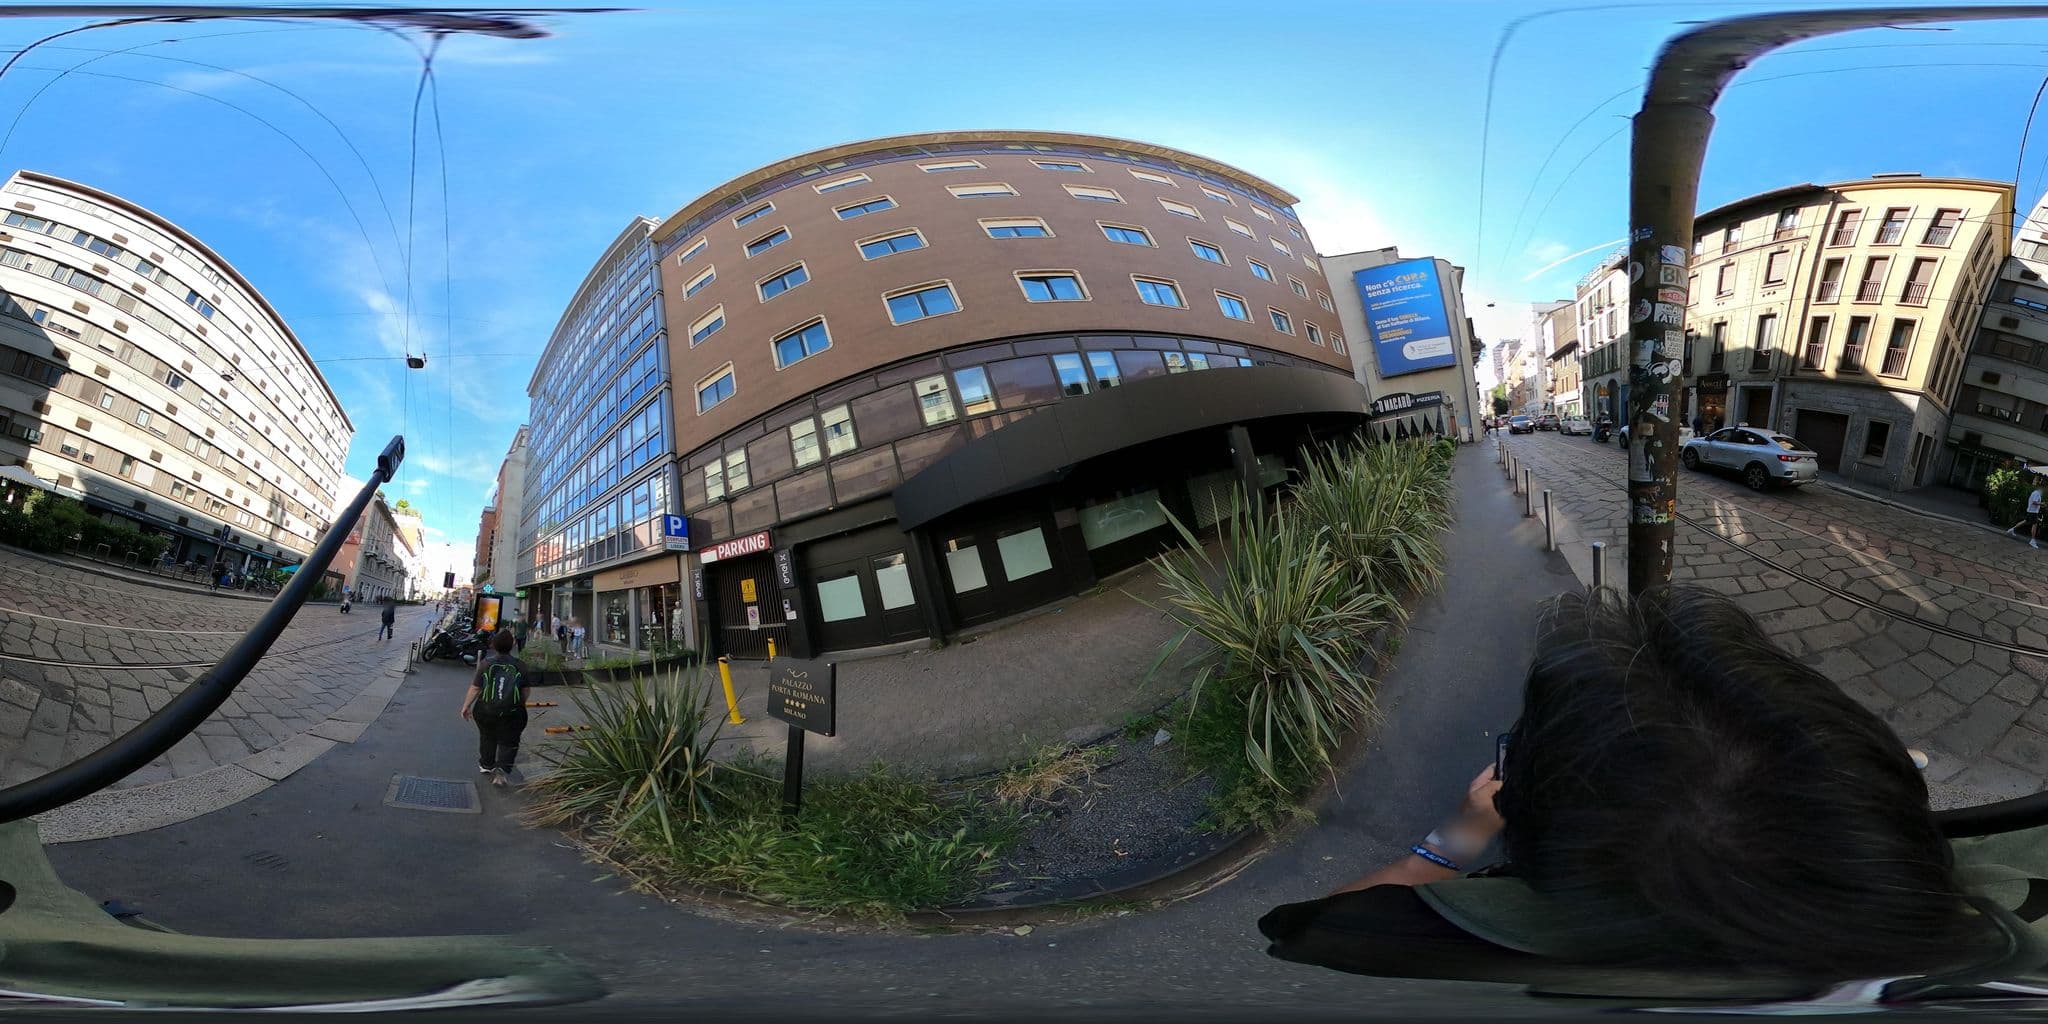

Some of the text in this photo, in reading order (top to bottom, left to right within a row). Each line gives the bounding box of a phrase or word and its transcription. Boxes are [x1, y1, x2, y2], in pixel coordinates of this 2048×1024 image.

[1366, 283, 1382, 292] Non
[1368, 282, 1424, 298] senza ricerca.
[1416, 394, 1440, 402] PIZZERIA
[669, 516, 682, 535] P
[718, 534, 766, 559] PARKING
[781, 563, 790, 585] enel
[782, 677, 813, 691] PALAZZO
[771, 684, 825, 705] PORTA ROMANA
[784, 707, 807, 720] MILANO
